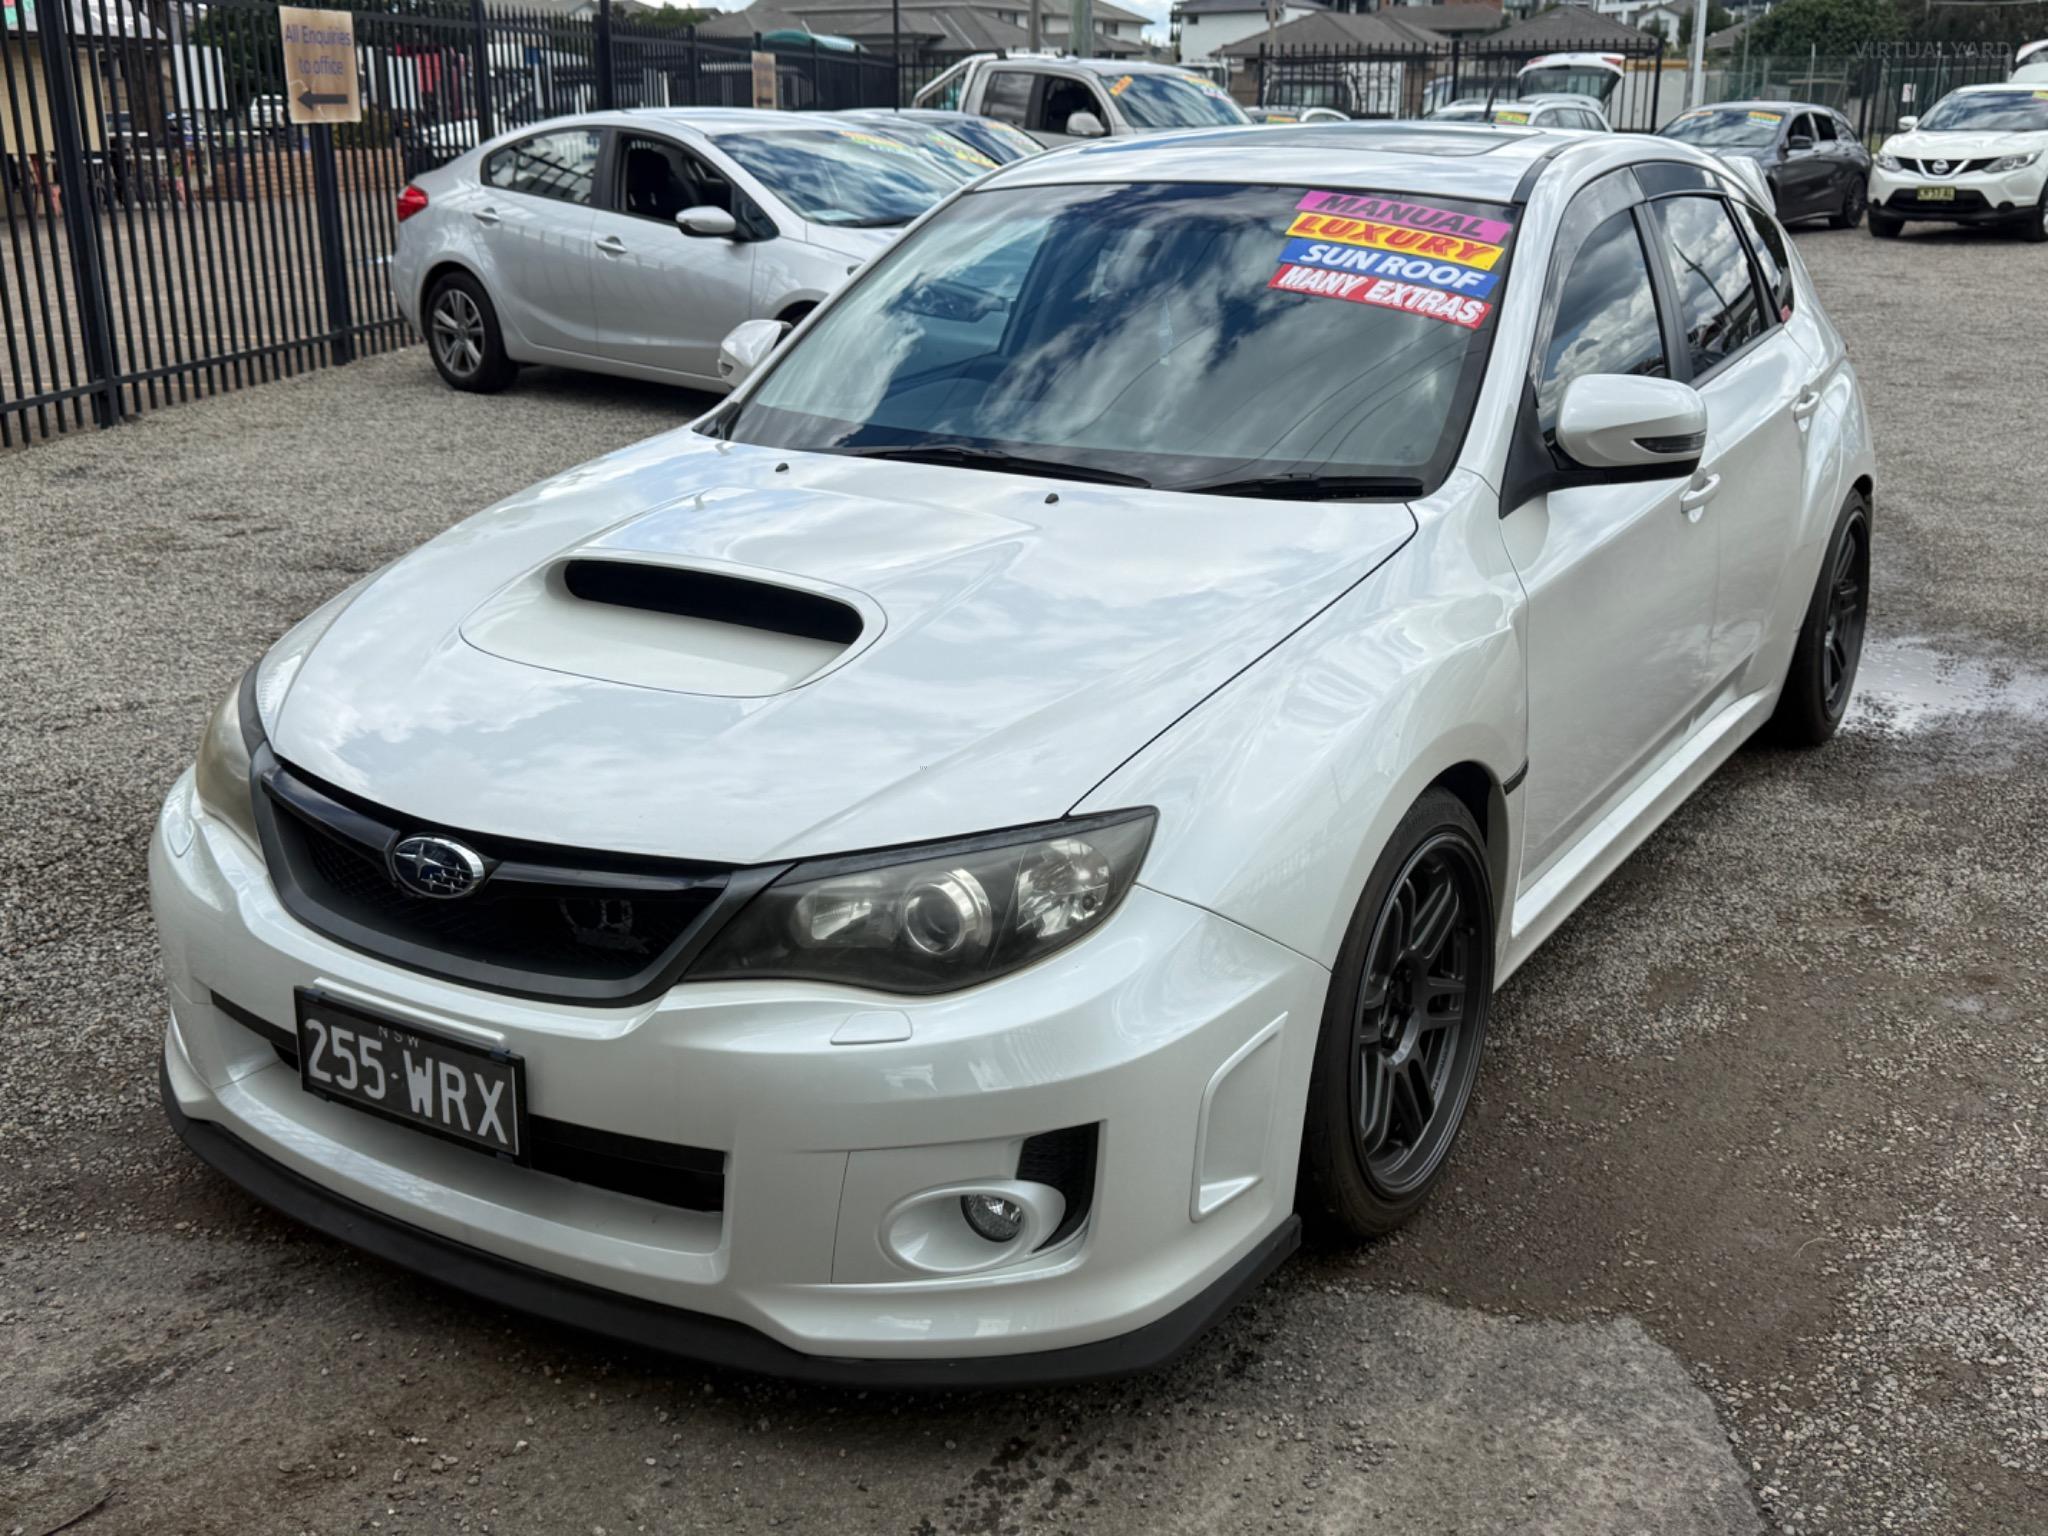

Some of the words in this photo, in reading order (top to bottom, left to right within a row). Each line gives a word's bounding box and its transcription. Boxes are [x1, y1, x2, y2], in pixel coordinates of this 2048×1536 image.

[286, 24, 299, 42] All
[299, 58, 311, 75] to
[314, 55, 344, 75] office
[1315, 195, 1483, 237] MANUAL
[1291, 215, 1496, 260] LUXURY
[1299, 244, 1383, 271] SUN
[1374, 256, 1487, 289] ROOF
[1276, 265, 1369, 297] MANY
[1363, 280, 1486, 325] EXTRAS
[377, 1025, 421, 1049] NSW
